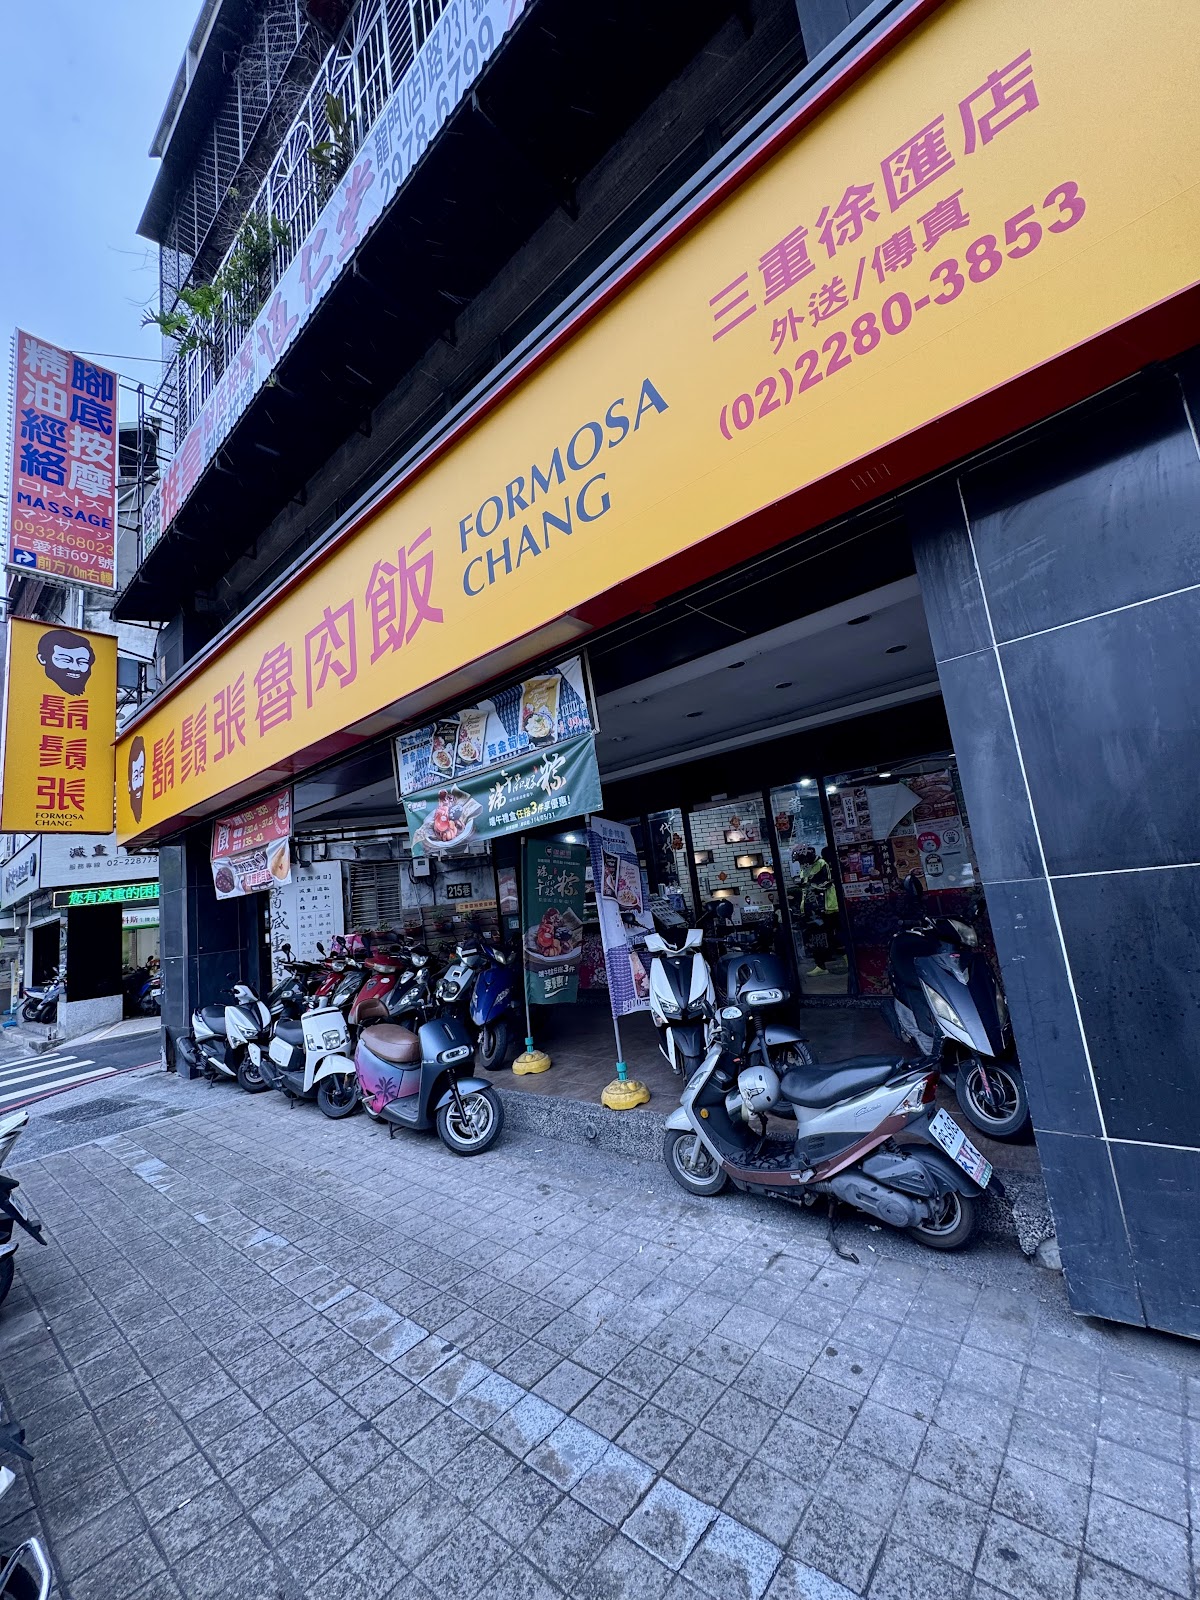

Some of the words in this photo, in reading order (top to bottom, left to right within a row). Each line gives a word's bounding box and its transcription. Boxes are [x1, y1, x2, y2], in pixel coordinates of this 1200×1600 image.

[381, 15, 494, 207] 2978-6799
[709, 48, 1041, 341] 三重徐匯店
[719, 180, 1087, 440] (02)2280-3853
[769, 188, 971, 355] 外送/傳真
[20, 338, 69, 487] 精油經絡
[68, 360, 113, 499] 腳底按摩
[459, 378, 669, 553] FORMOSA
[12, 533, 114, 571] 仁愛街697號
[13, 519, 114, 556] 0932468023
[17, 491, 112, 530] MASSAGE
[18, 478, 112, 517] 마사지
[463, 473, 611, 597] CHANG
[37, 556, 113, 585] 前方70m右轉
[151, 527, 444, 800] 鬍鬚張魯肉飯
[36, 694, 89, 811] 鬍鬚張
[35, 812, 84, 821] FORMOSA
[35, 819, 73, 827] CHANG
[69, 843, 108, 858] 減重
[448, 884, 471, 898] 215巷
